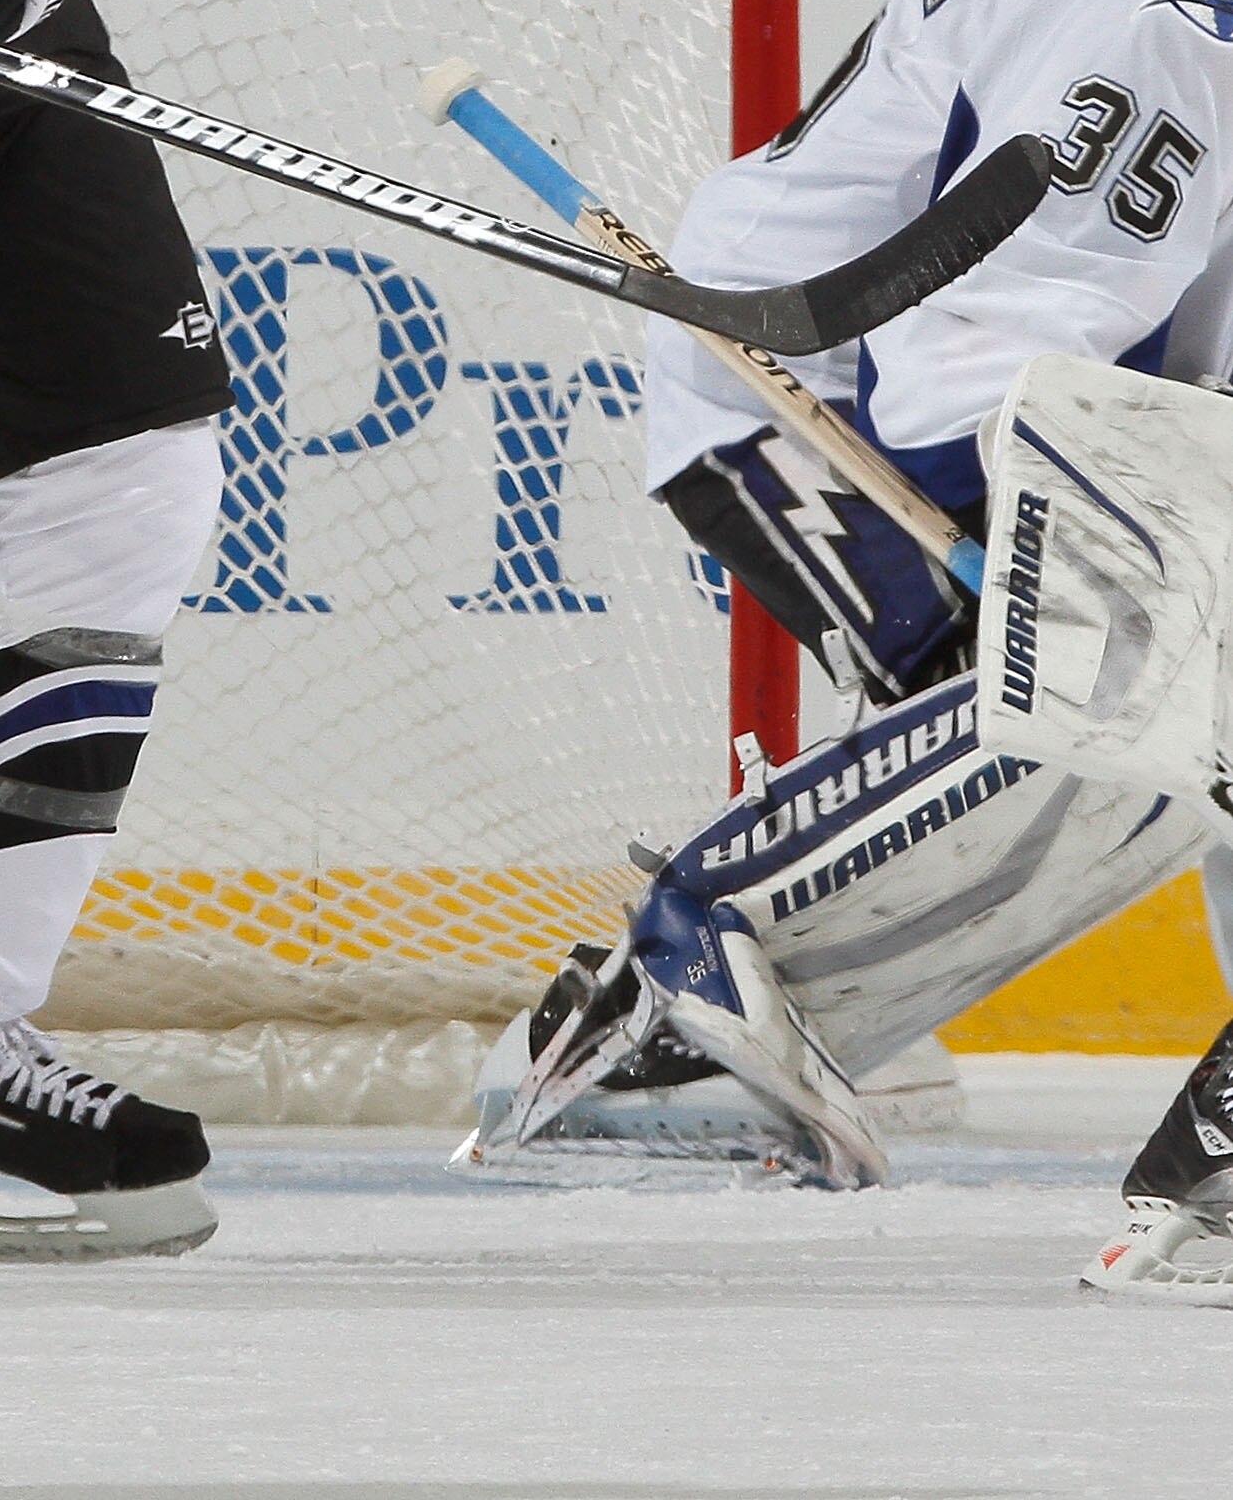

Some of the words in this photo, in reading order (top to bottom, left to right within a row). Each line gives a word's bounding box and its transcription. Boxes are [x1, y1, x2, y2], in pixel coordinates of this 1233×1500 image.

[86, 84, 497, 243] WARRIOR
[1040, 74, 1209, 244] 35
[1002, 488, 1050, 715] WARRIOR
[687, 960, 707, 986] 35
[1203, 1129, 1225, 1151] CCM
